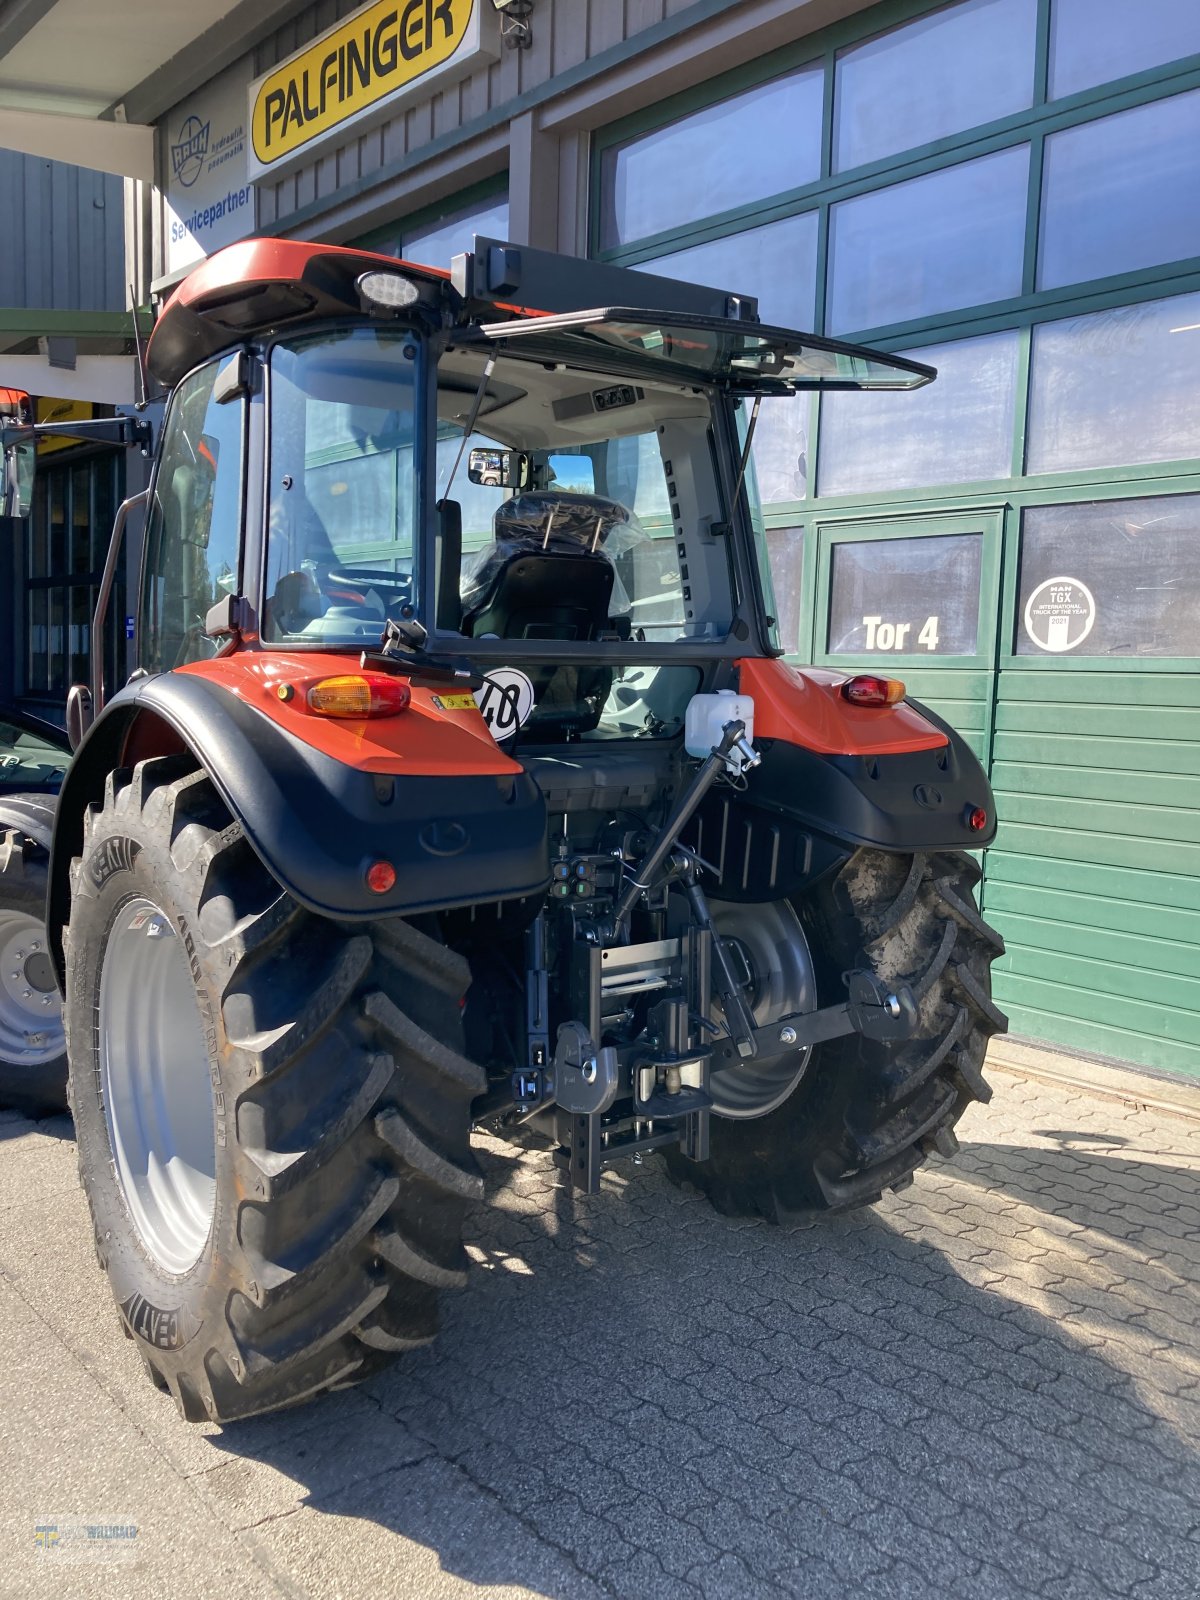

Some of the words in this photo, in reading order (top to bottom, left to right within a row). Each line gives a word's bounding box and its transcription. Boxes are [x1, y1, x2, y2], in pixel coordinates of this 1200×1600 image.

[265, 0, 454, 147] PALFINGER
[211, 125, 243, 153] hydraulik
[207, 142, 243, 174] pneumatik
[172, 185, 251, 243] Servicepartner
[1050, 592, 1072, 603] TGX
[862, 616, 911, 650] Tor
[918, 616, 939, 650] 4
[1051, 617, 1067, 625] 2021
[480, 684, 521, 729] 40
[91, 839, 124, 882] CEAT
[139, 1306, 179, 1347] CEAT
